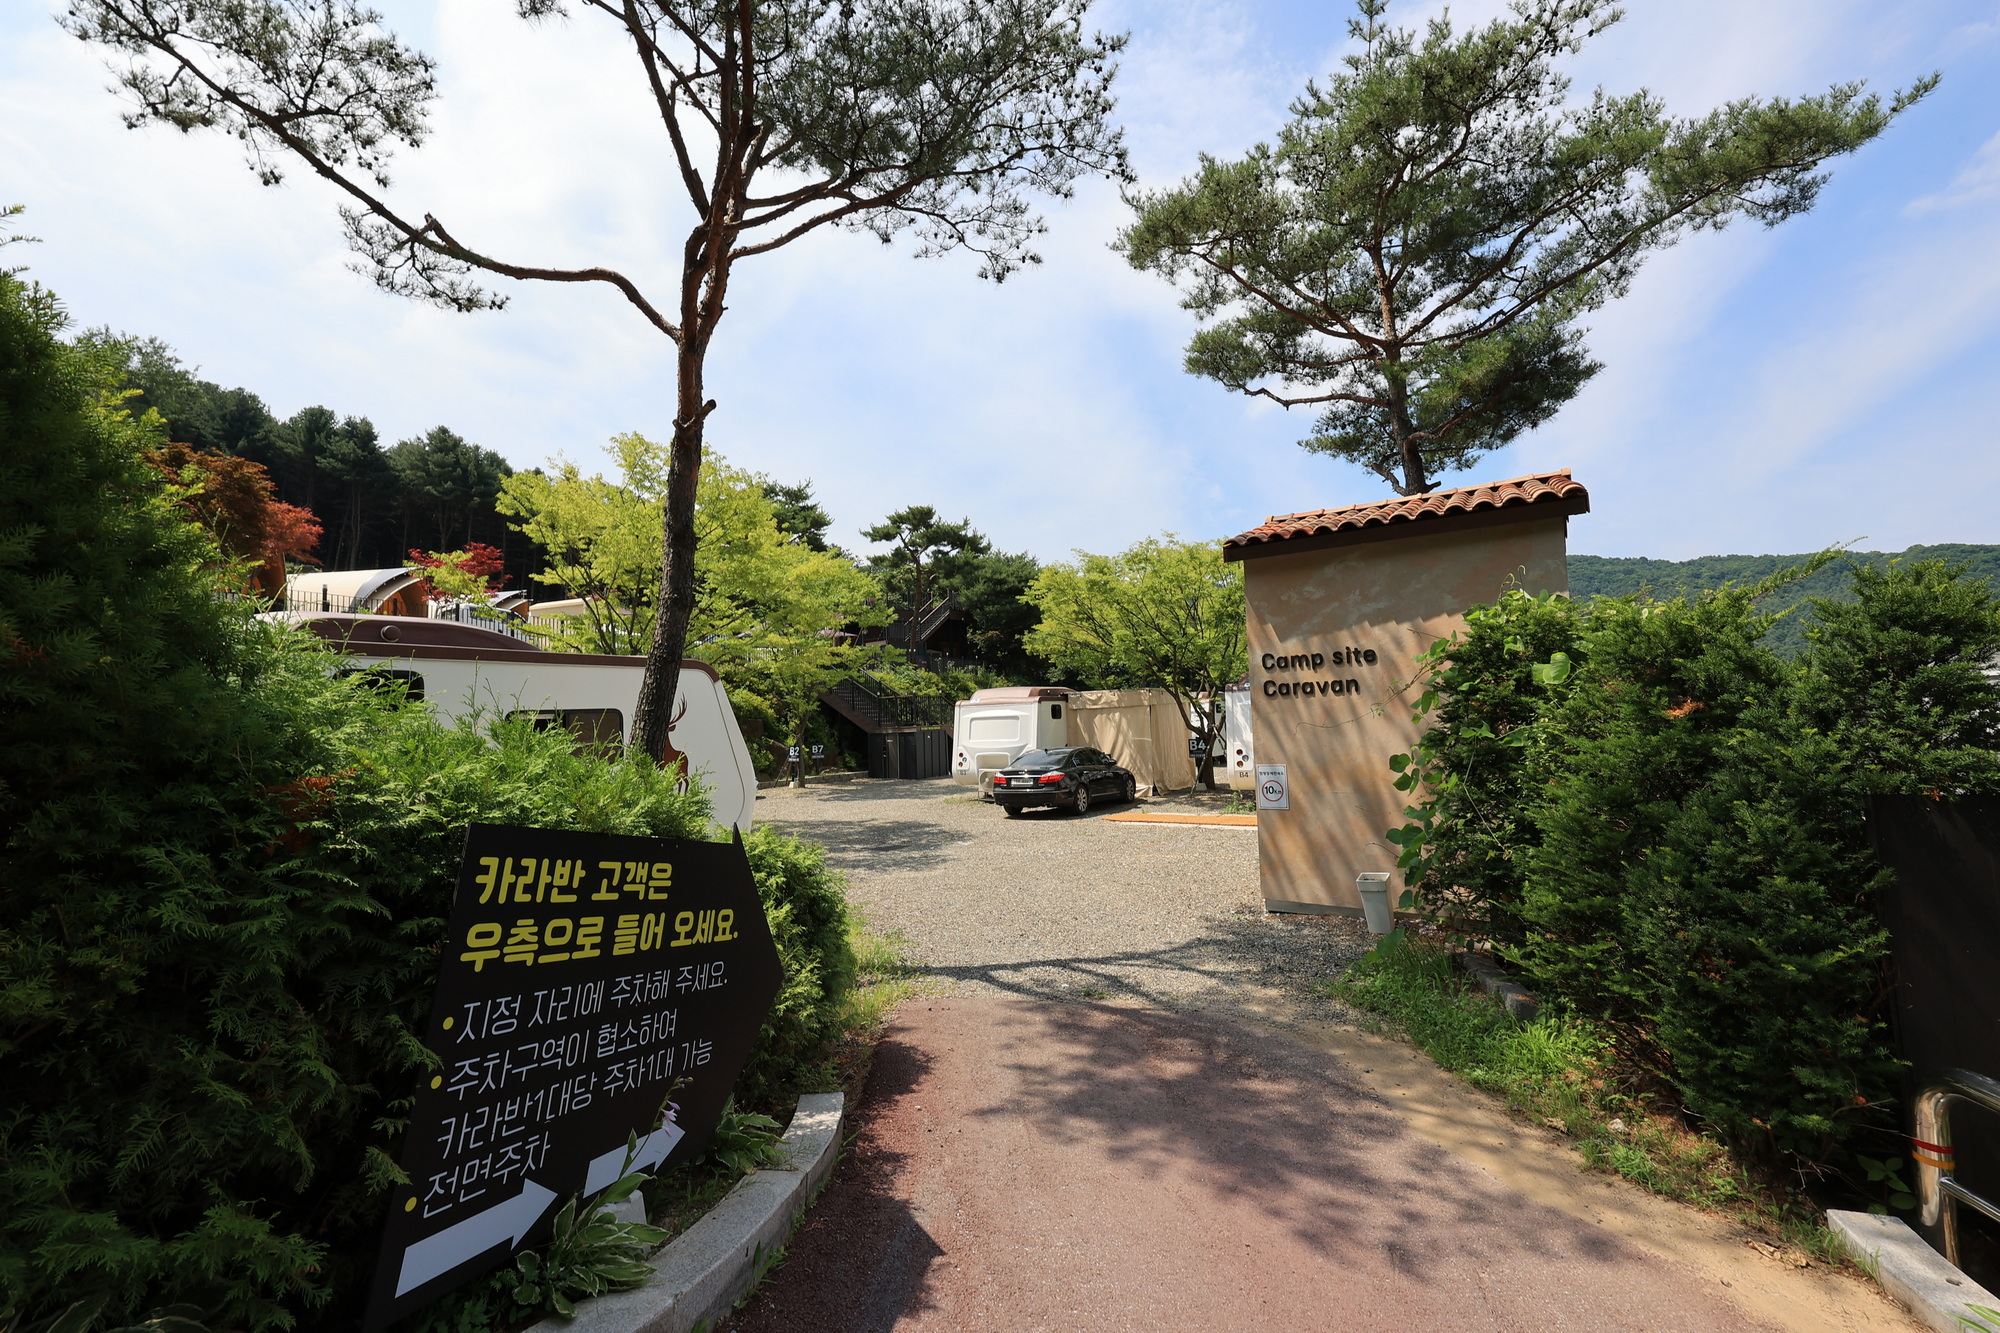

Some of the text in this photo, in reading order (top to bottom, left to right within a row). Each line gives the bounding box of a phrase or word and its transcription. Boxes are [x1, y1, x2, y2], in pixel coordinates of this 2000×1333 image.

[1261, 646, 1377, 673] Camp site
[1263, 677, 1360, 697] Caravan
[789, 746, 800, 756] B2
[812, 745, 824, 753] B7
[1190, 740, 1206, 751] B4
[475, 857, 673, 904] 카라반 고객은
[460, 908, 738, 972] 우측으로 들어 오세요.
[456, 961, 728, 1043] 지정 자리에 주차해 주세요.
[447, 1008, 678, 1100] 주차구역이 협소하여
[681, 1038, 713, 1071] 가능
[423, 1131, 551, 1218] 전면주차
